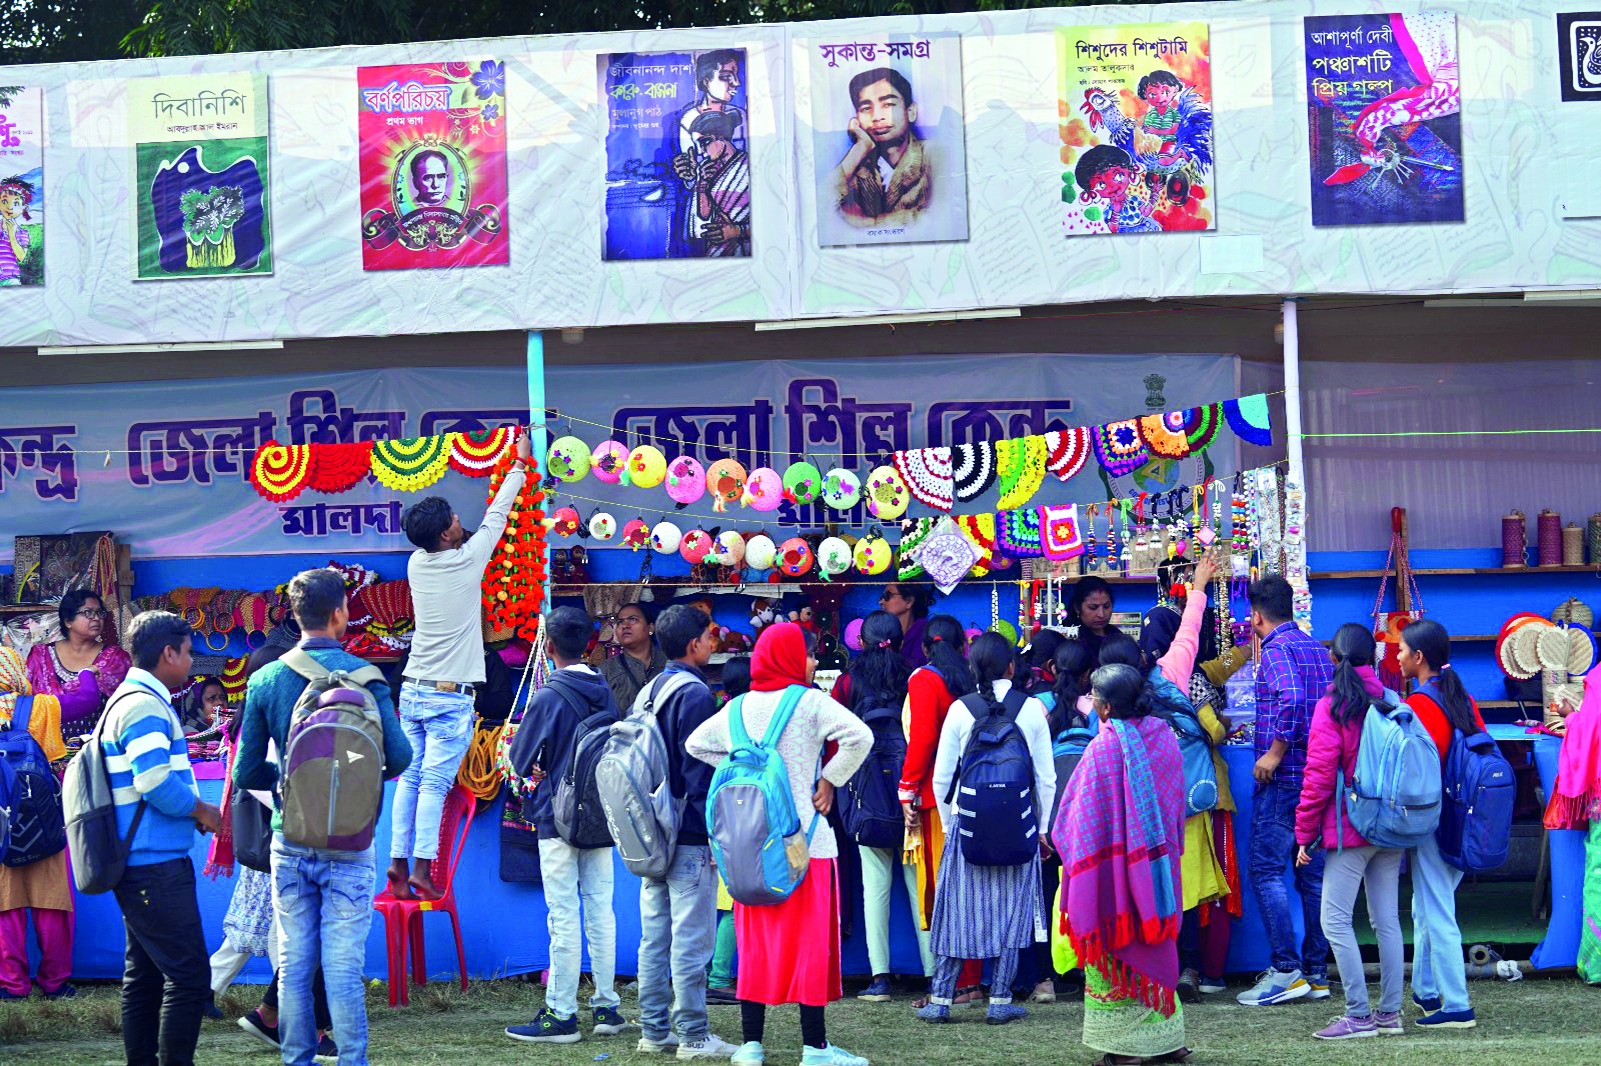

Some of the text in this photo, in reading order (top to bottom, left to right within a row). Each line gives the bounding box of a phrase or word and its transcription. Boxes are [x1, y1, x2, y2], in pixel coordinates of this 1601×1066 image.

[1075, 36, 1189, 61] শিশুদের শিশুটামি
[1311, 24, 1393, 49] আশাপূর্ণা দেবী
[819, 39, 931, 67] সুকান্ত-সমগ্র
[1312, 49, 1393, 75] পঞ্চাশটি
[610, 63, 693, 77] জীবনানন্দ দাশ
[365, 82, 449, 112] বর্ণপরিচয়
[1312, 78, 1393, 97] প্রিয় গল্প
[151, 89, 247, 119] দিবানিশি
[215, 122, 238, 131] ইমরান
[386, 116, 424, 126] প্রথম ভাগ
[279, 500, 403, 535] মালদা
